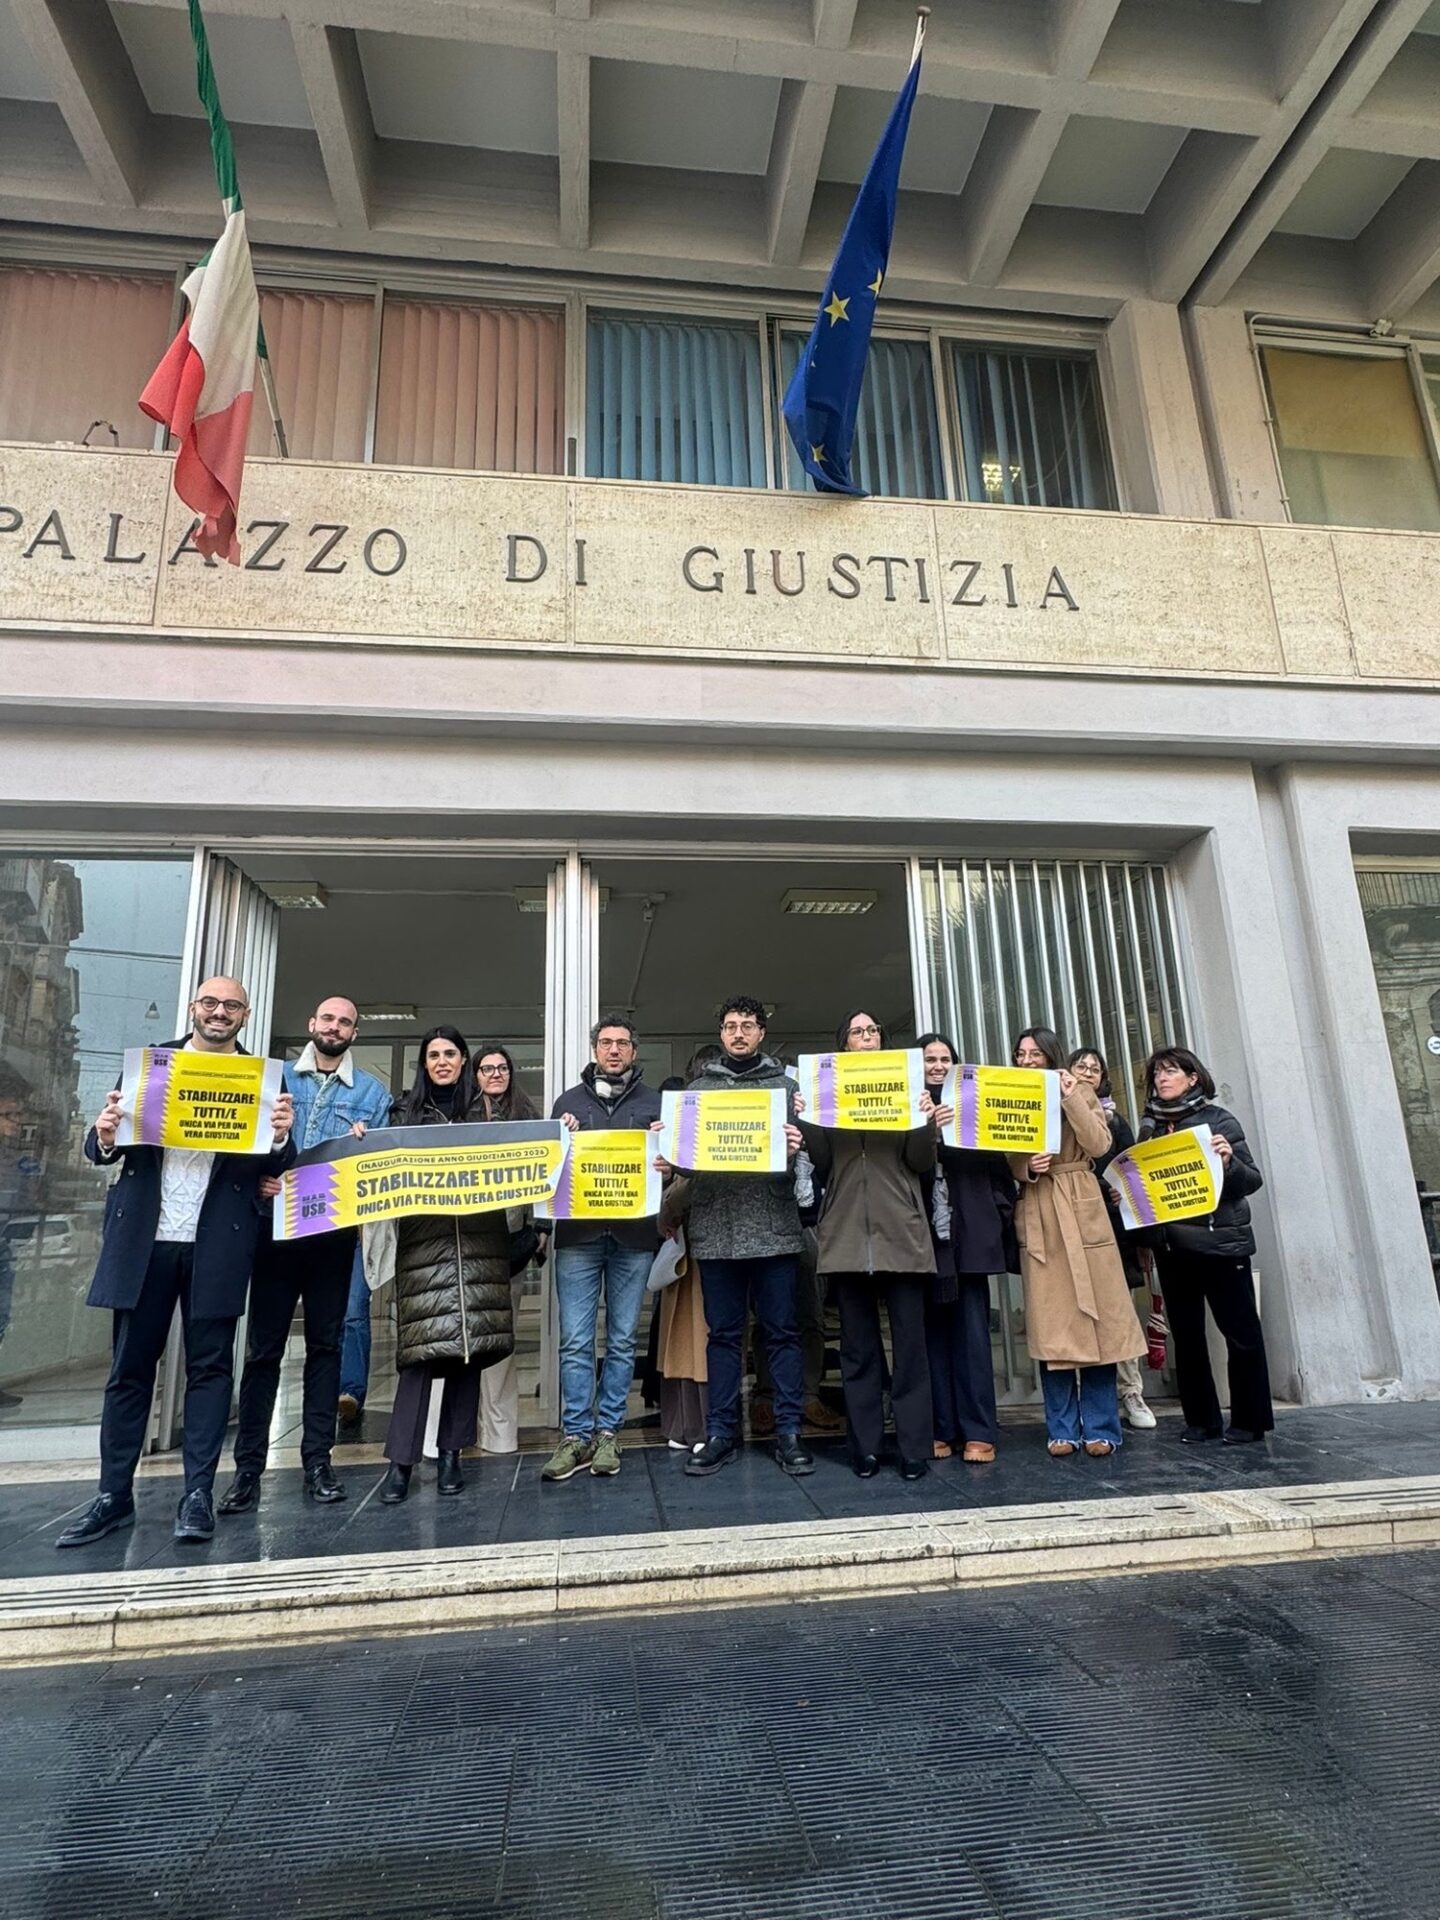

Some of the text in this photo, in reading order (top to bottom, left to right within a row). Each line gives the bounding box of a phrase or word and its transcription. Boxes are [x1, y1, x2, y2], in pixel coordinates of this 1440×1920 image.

[505, 533, 587, 586] DI
[682, 545, 1081, 612] GIUSTIZIA
[844, 1082, 904, 1094] STABILIZZARE
[178, 1089, 255, 1104] STABILIZZARE
[857, 1096, 892, 1108] TUTTI/E
[985, 1098, 1042, 1111] STABILIZZARE
[193, 1106, 238, 1120] TUTTI/E
[997, 1112, 1030, 1124] TUTTI/E
[179, 1120, 247, 1130] UNICA VIA PER UNA
[706, 1121, 766, 1131] STABILIZZARE
[1006, 1124, 1016, 1132] VIA
[184, 1130, 240, 1140] VERA GIUSTIZIA
[718, 1135, 752, 1144] TUTTI/E
[361, 1156, 436, 1170] INAUGURAZIONE
[438, 1155, 464, 1163] ANNO
[466, 1151, 522, 1161] GIUDIZIARIO
[580, 1162, 642, 1174] STABILIZZARE
[1148, 1160, 1205, 1182] STABILIZZARE
[356, 1163, 548, 1198] STABILIZZARE TUTTI/E
[594, 1178, 628, 1188] TUTTI/E
[1164, 1176, 1198, 1192] TUTTI/E
[356, 1184, 551, 1216] UNICA VIA PER UNA VERA GIUSTIZIA
[584, 1190, 602, 1198] UNICA
[603, 1190, 614, 1198] VIA
[302, 1202, 326, 1218] USB
